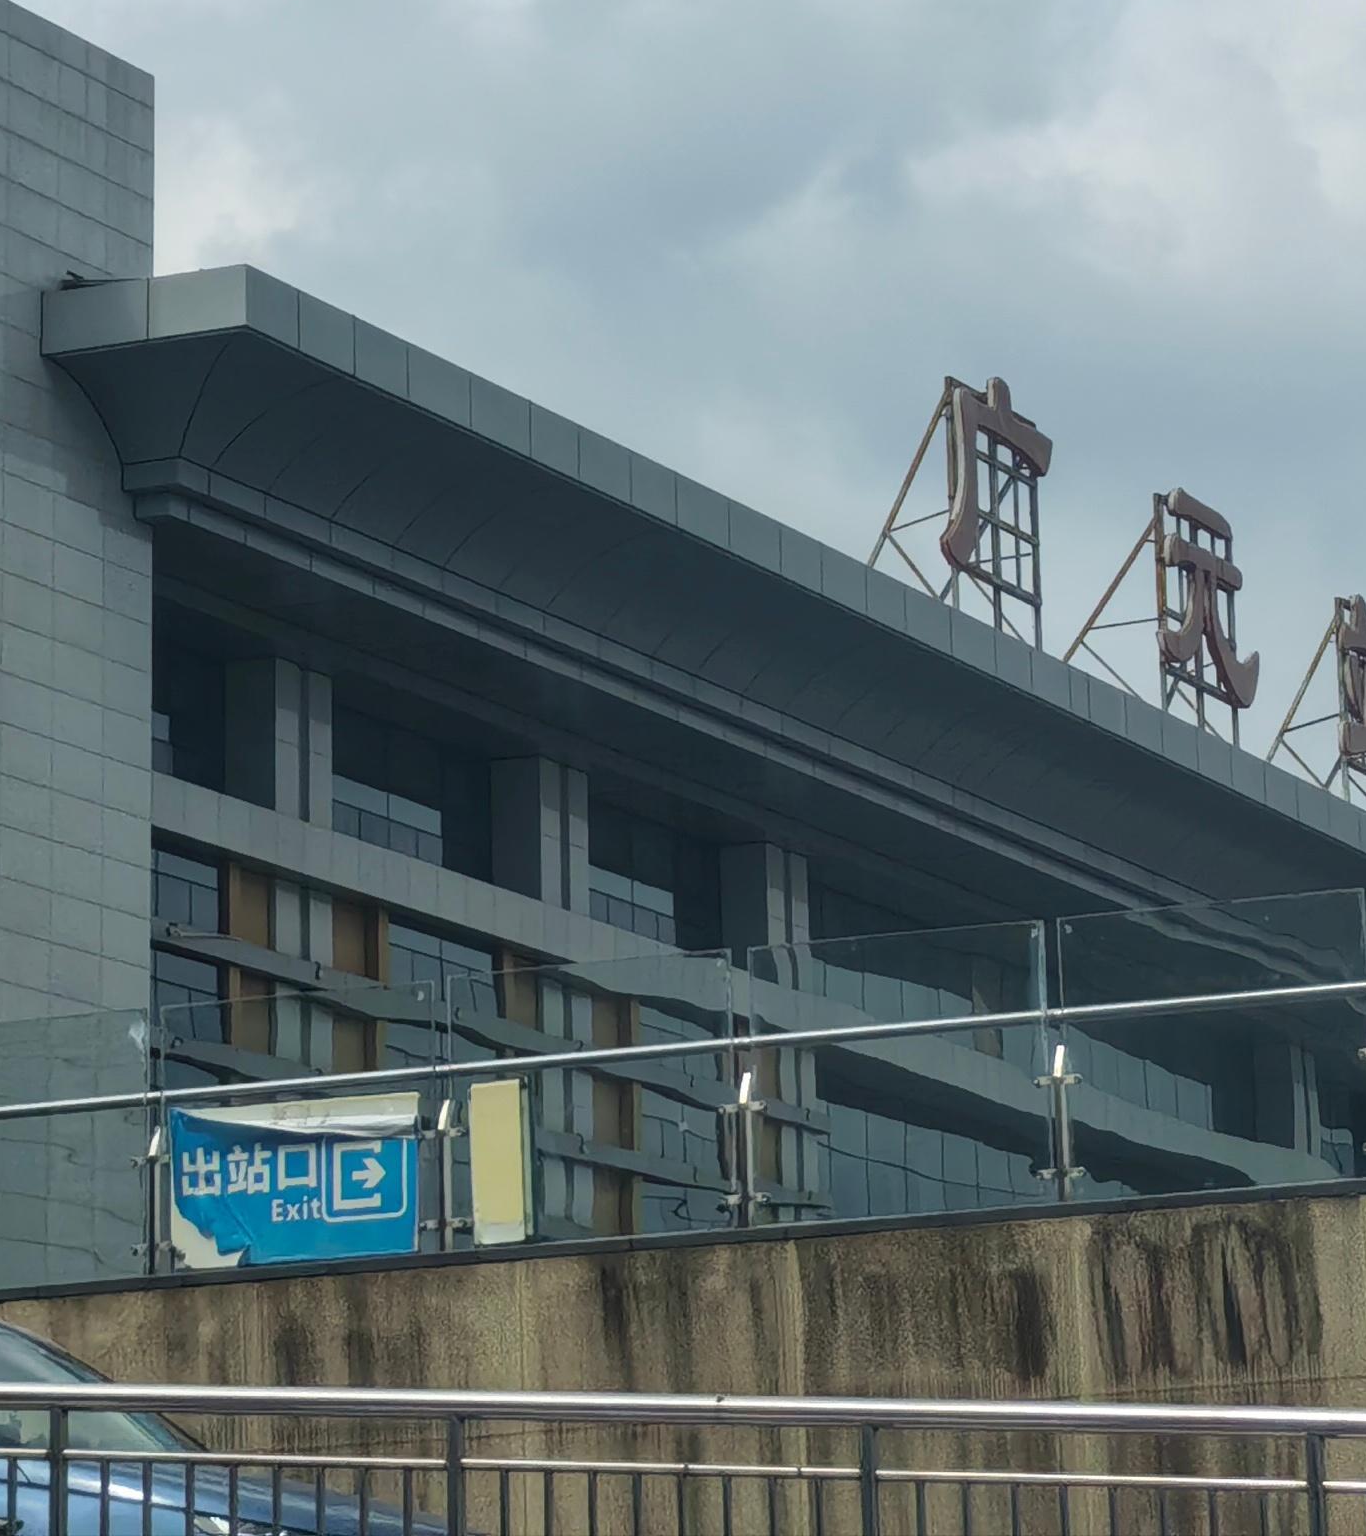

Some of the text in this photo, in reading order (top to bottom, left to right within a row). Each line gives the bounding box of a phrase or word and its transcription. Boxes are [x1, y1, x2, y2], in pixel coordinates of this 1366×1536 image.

[182, 1142, 318, 1196] 出站口
[272, 1197, 322, 1223] Exit
